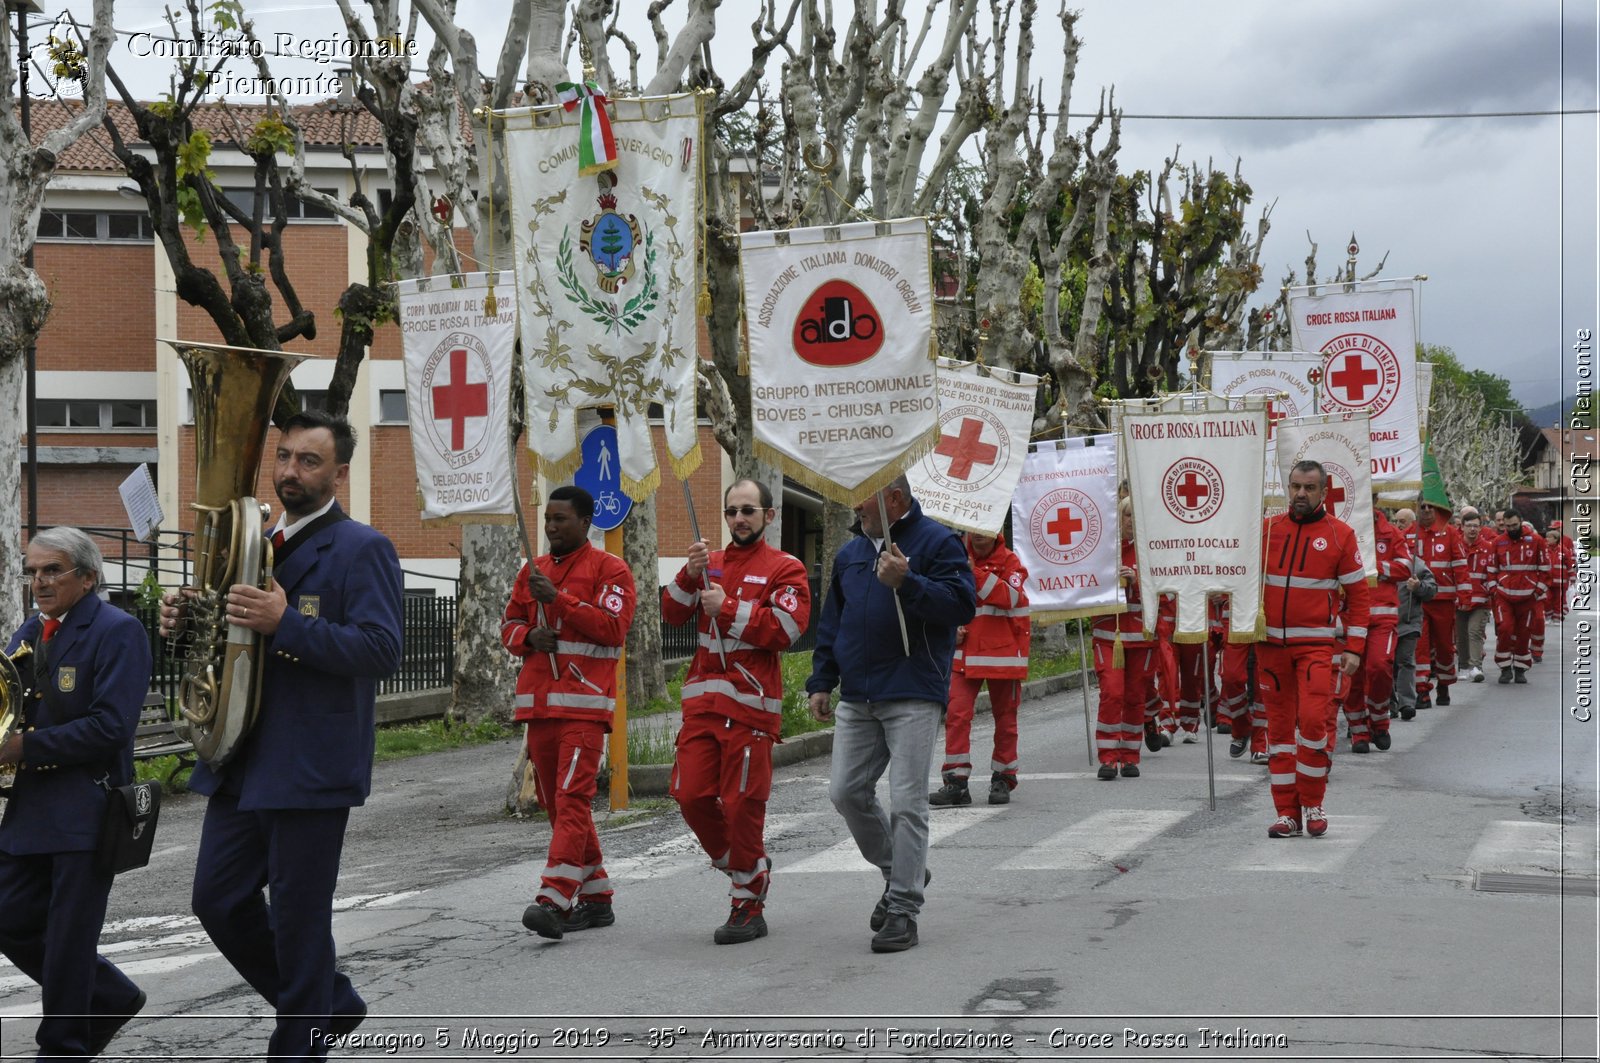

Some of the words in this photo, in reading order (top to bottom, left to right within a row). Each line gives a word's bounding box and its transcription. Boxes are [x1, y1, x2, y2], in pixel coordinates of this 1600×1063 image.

[538, 142, 580, 173] COMUN
[757, 264, 801, 329] ASSOCIAZIONE
[799, 251, 848, 273] ITALIANA
[853, 251, 900, 282] DONATORI
[896, 279, 923, 315] ORGANI
[406, 304, 425, 317] CORPO
[464, 299, 478, 311] DEL
[1306, 312, 1332, 326] CROCE
[1334, 310, 1360, 323] ROSSA
[1362, 308, 1396, 322] ITALIANA
[402, 318, 437, 333] CROCE
[440, 315, 470, 329] ROSSA
[1361, 337, 1373, 350] DI
[1373, 345, 1396, 385] GINEVRA
[755, 384, 810, 401] GRUPPO
[814, 374, 932, 398] INTERCOMUNALE
[953, 380, 985, 394] VOLONTARI
[986, 386, 998, 397] DEL
[999, 389, 1030, 402] SOCCORSO
[1248, 368, 1276, 379] ROSSA
[1278, 371, 1310, 397] ITALIANA
[756, 407, 807, 422] BOVES
[827, 402, 884, 419] CHIUSA
[890, 396, 934, 416] PESIO
[938, 387, 957, 399] OCE
[958, 392, 990, 405] ROSSA
[992, 398, 1033, 413] ITALIANA
[798, 424, 894, 446] PEVERAGNO
[1130, 423, 1165, 440] CROCE
[1166, 421, 1201, 439] ROSSA
[1203, 418, 1257, 438] ITALIANA
[1370, 430, 1399, 442] OCALE
[1308, 431, 1335, 443] ROSSA
[1335, 433, 1363, 468] ITALIANA
[1019, 474, 1043, 484] CROCE
[1045, 470, 1070, 481] ROSSA
[1070, 466, 1110, 478] ITALIANA
[917, 496, 979, 521] MORETTA
[959, 498, 993, 513] LOCALE
[1049, 490, 1083, 506] GINEVRA
[1148, 538, 1195, 550] COMITATO
[1197, 537, 1240, 549] LOCALE
[1186, 551, 1195, 562] DI
[1193, 565, 1213, 575] DEL
[1215, 565, 1247, 576] BOSCO
[1038, 573, 1100, 592] MANTA
